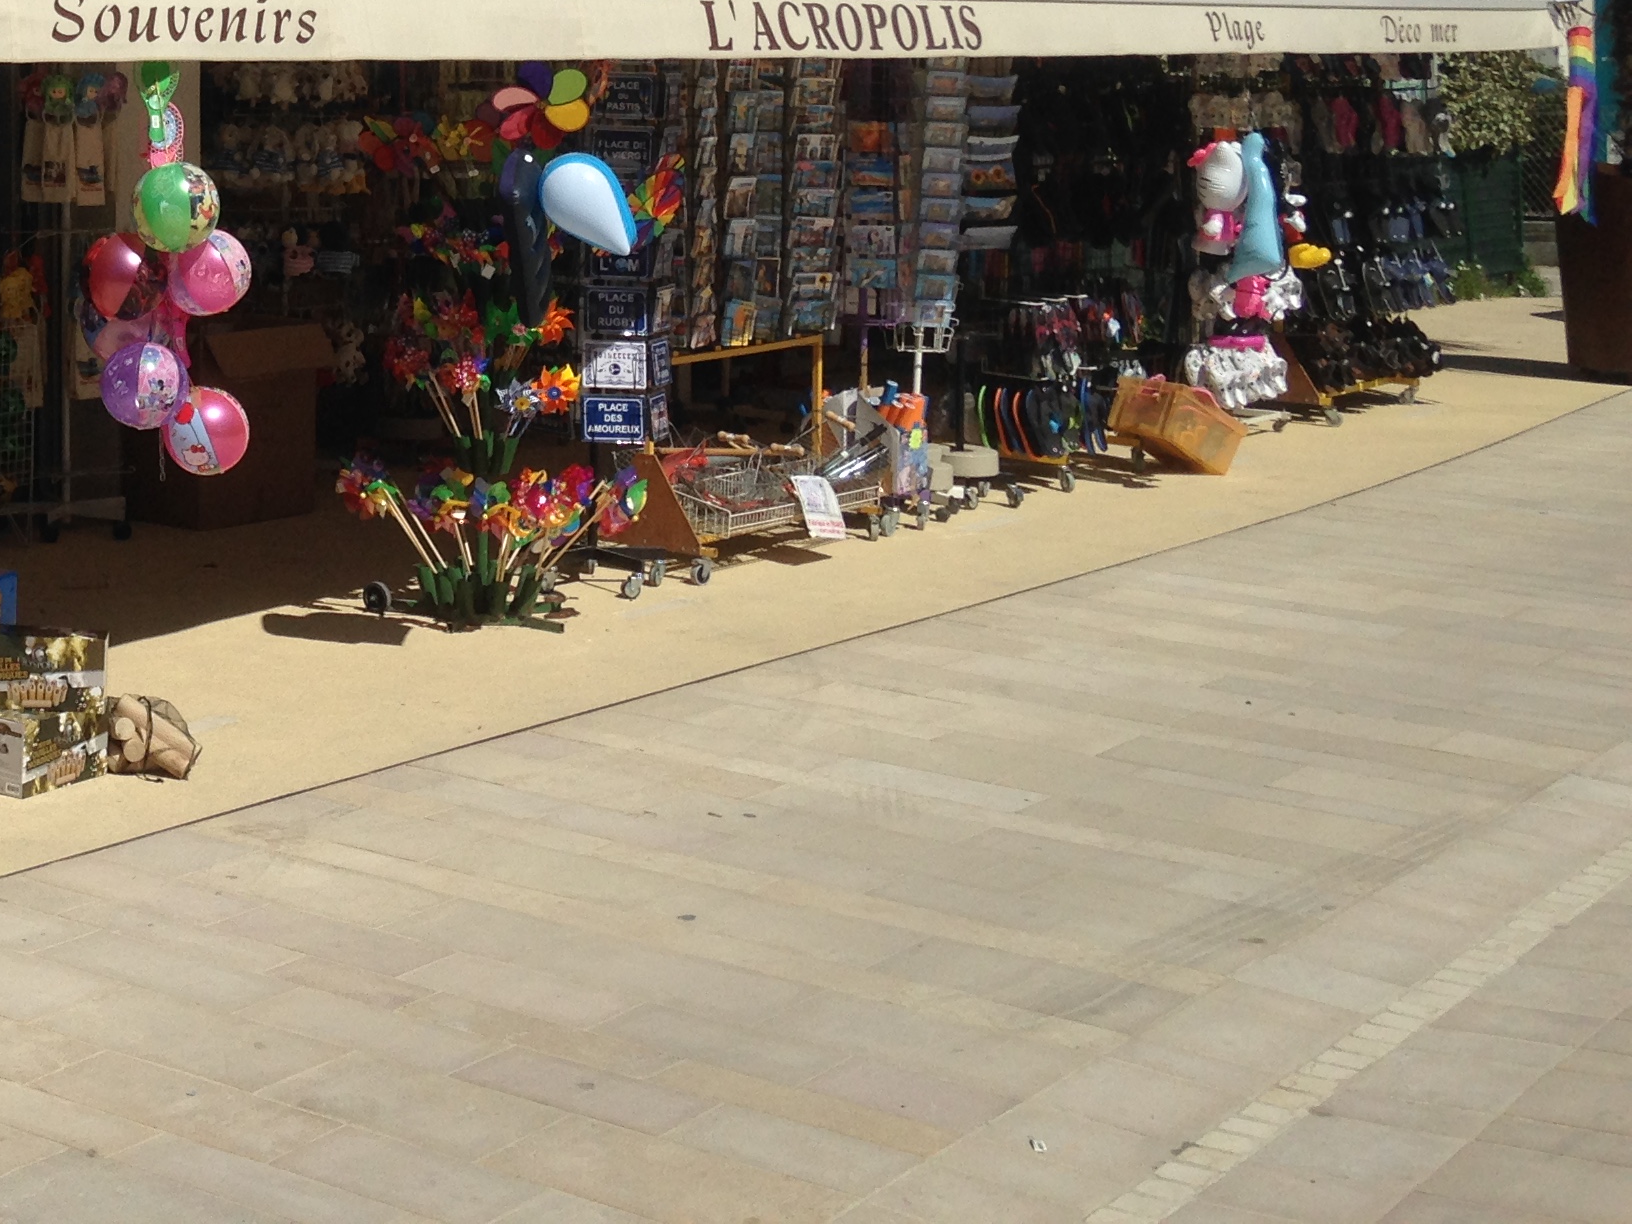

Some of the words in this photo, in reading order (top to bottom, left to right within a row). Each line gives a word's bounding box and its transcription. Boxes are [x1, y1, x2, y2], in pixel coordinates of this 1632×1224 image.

[700, 0, 983, 51] L'ACROPOLIS
[1205, 11, 1265, 50] Plage
[1380, 15, 1421, 43] Déco
[1430, 23, 1458, 43] mer
[607, 81, 640, 90] PLACE
[606, 102, 641, 111] PASTIS
[598, 293, 635, 303] PLACE
[608, 305, 624, 315] DU
[597, 317, 636, 327] RUGBY
[598, 403, 629, 412] PLACE
[604, 414, 623, 423] DES
[587, 425, 641, 434] AMOUREUX
